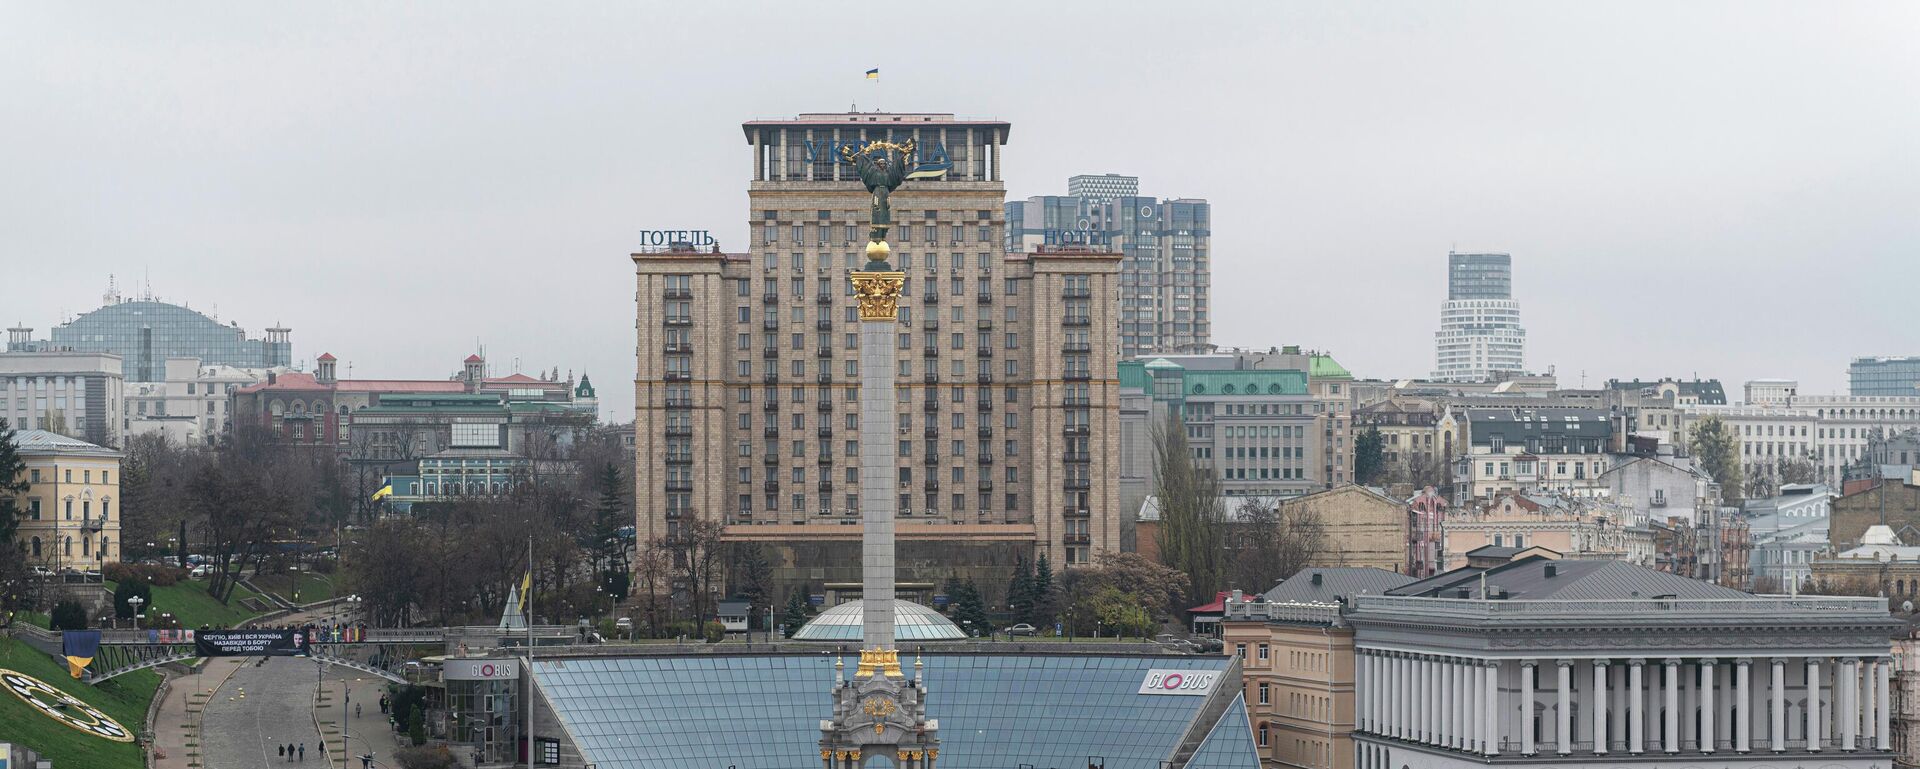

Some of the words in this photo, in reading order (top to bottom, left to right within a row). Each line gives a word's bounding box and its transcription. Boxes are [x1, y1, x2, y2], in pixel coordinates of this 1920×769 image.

[639, 230, 714, 246] ГОТЕЛЬ
[1044, 230, 1109, 246] HOTEL
[471, 664, 511, 677] GLOBUS
[1148, 672, 1212, 690] GLOBUS
